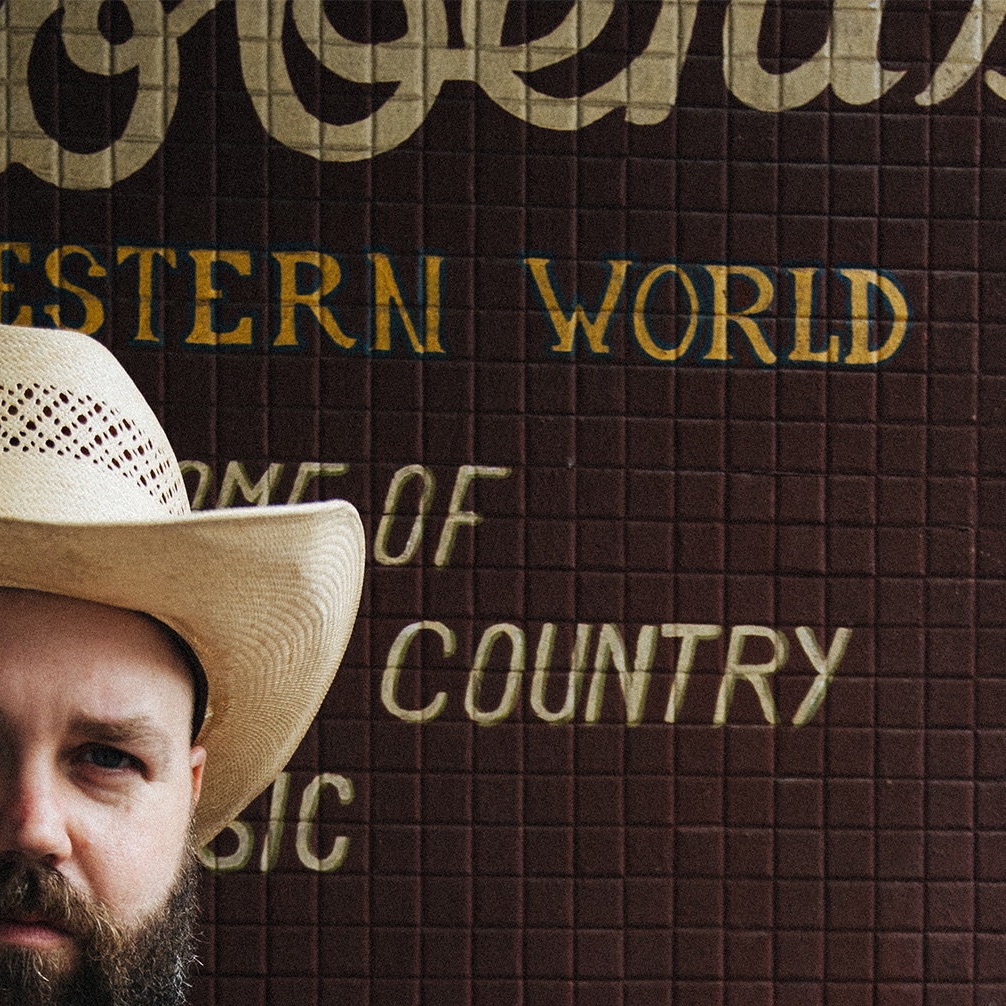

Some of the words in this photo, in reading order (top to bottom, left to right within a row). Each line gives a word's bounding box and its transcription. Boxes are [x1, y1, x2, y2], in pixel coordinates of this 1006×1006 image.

[521, 256, 911, 366] WORLD
[373, 463, 512, 567] OF
[381, 620, 853, 726] COUNTRY
